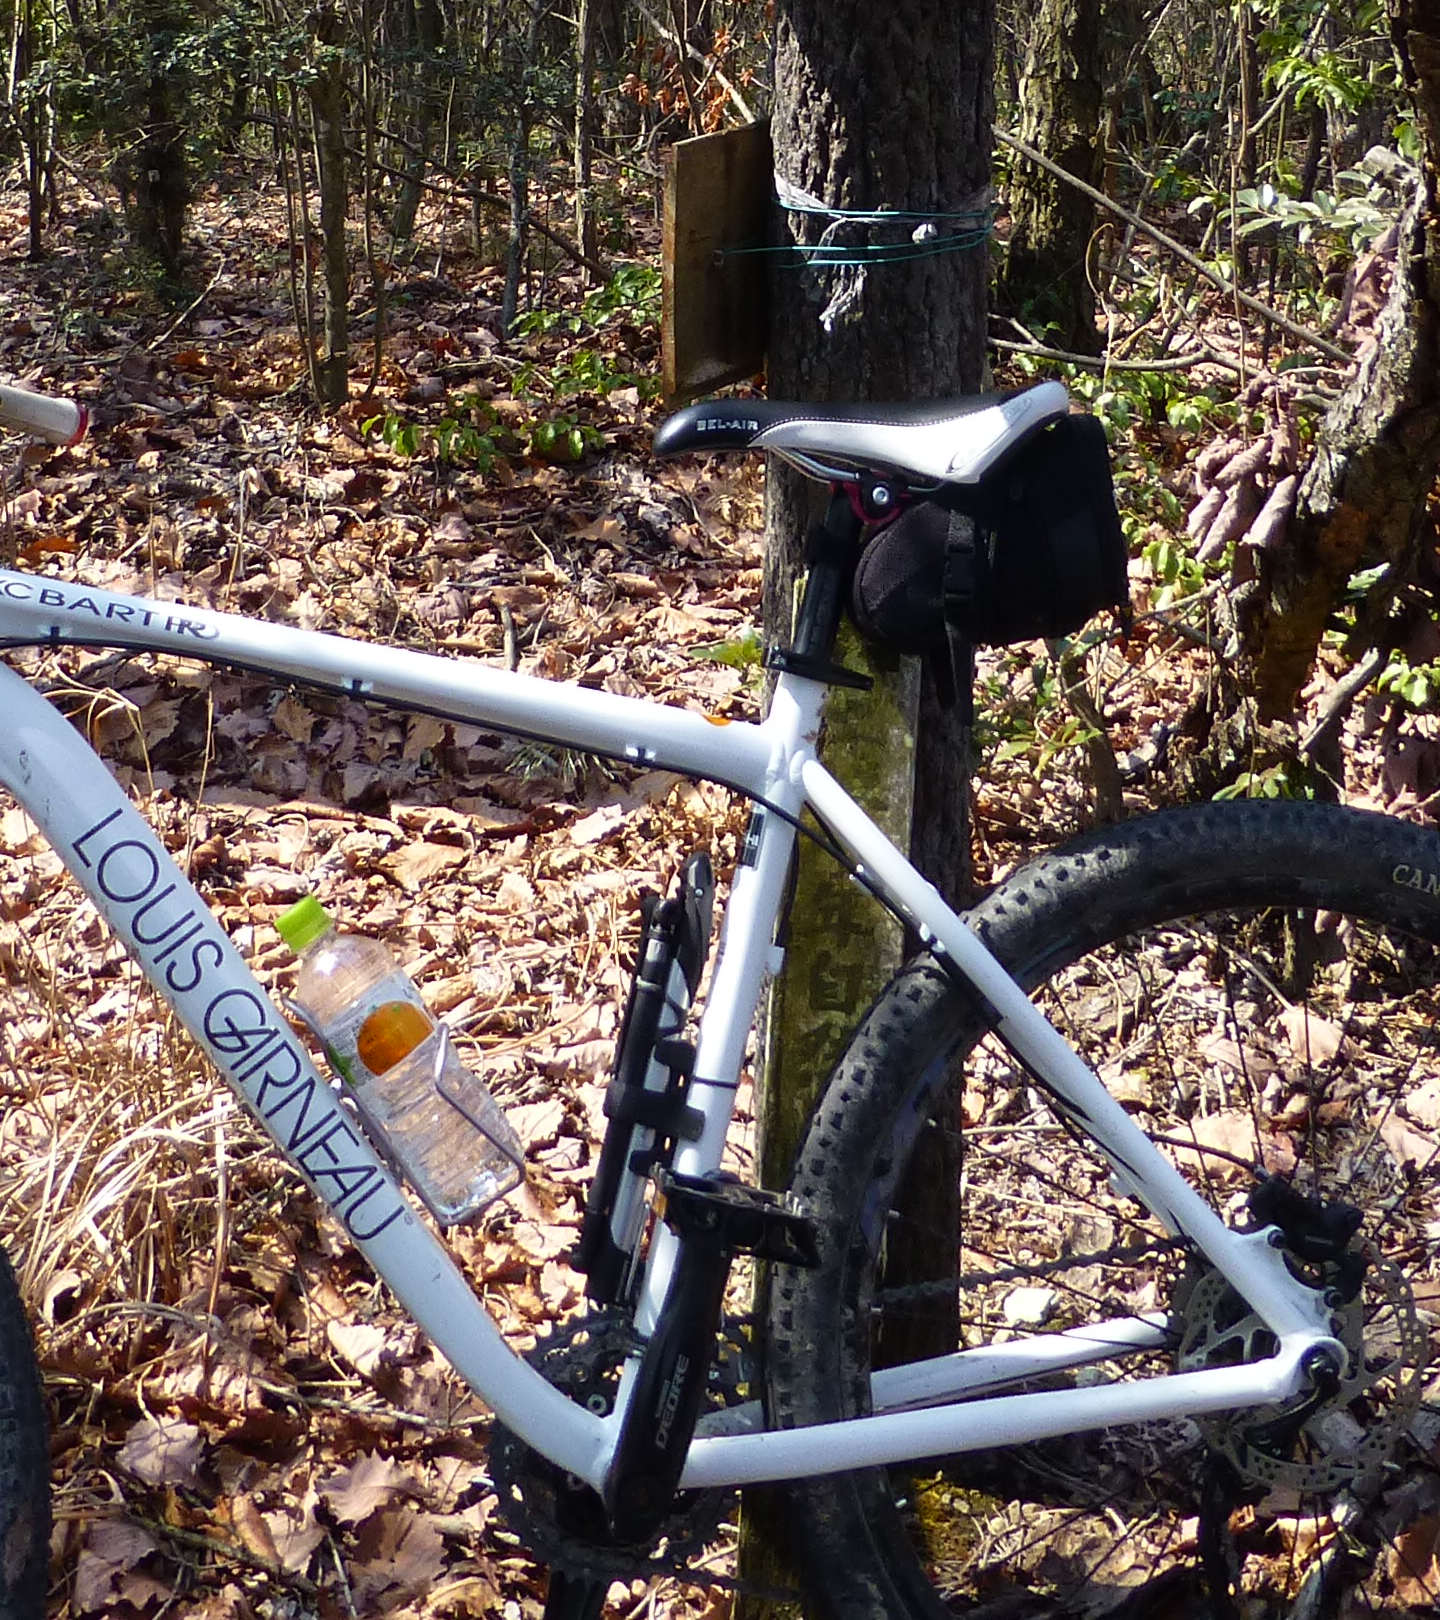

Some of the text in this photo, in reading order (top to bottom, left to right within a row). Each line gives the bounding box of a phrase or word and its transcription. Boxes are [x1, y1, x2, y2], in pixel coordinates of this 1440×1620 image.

[696, 418, 759, 432] BEL-AIR
[71, 807, 406, 1241] LOUIS GARNEAU
[655, 1353, 691, 1451] DEORE
